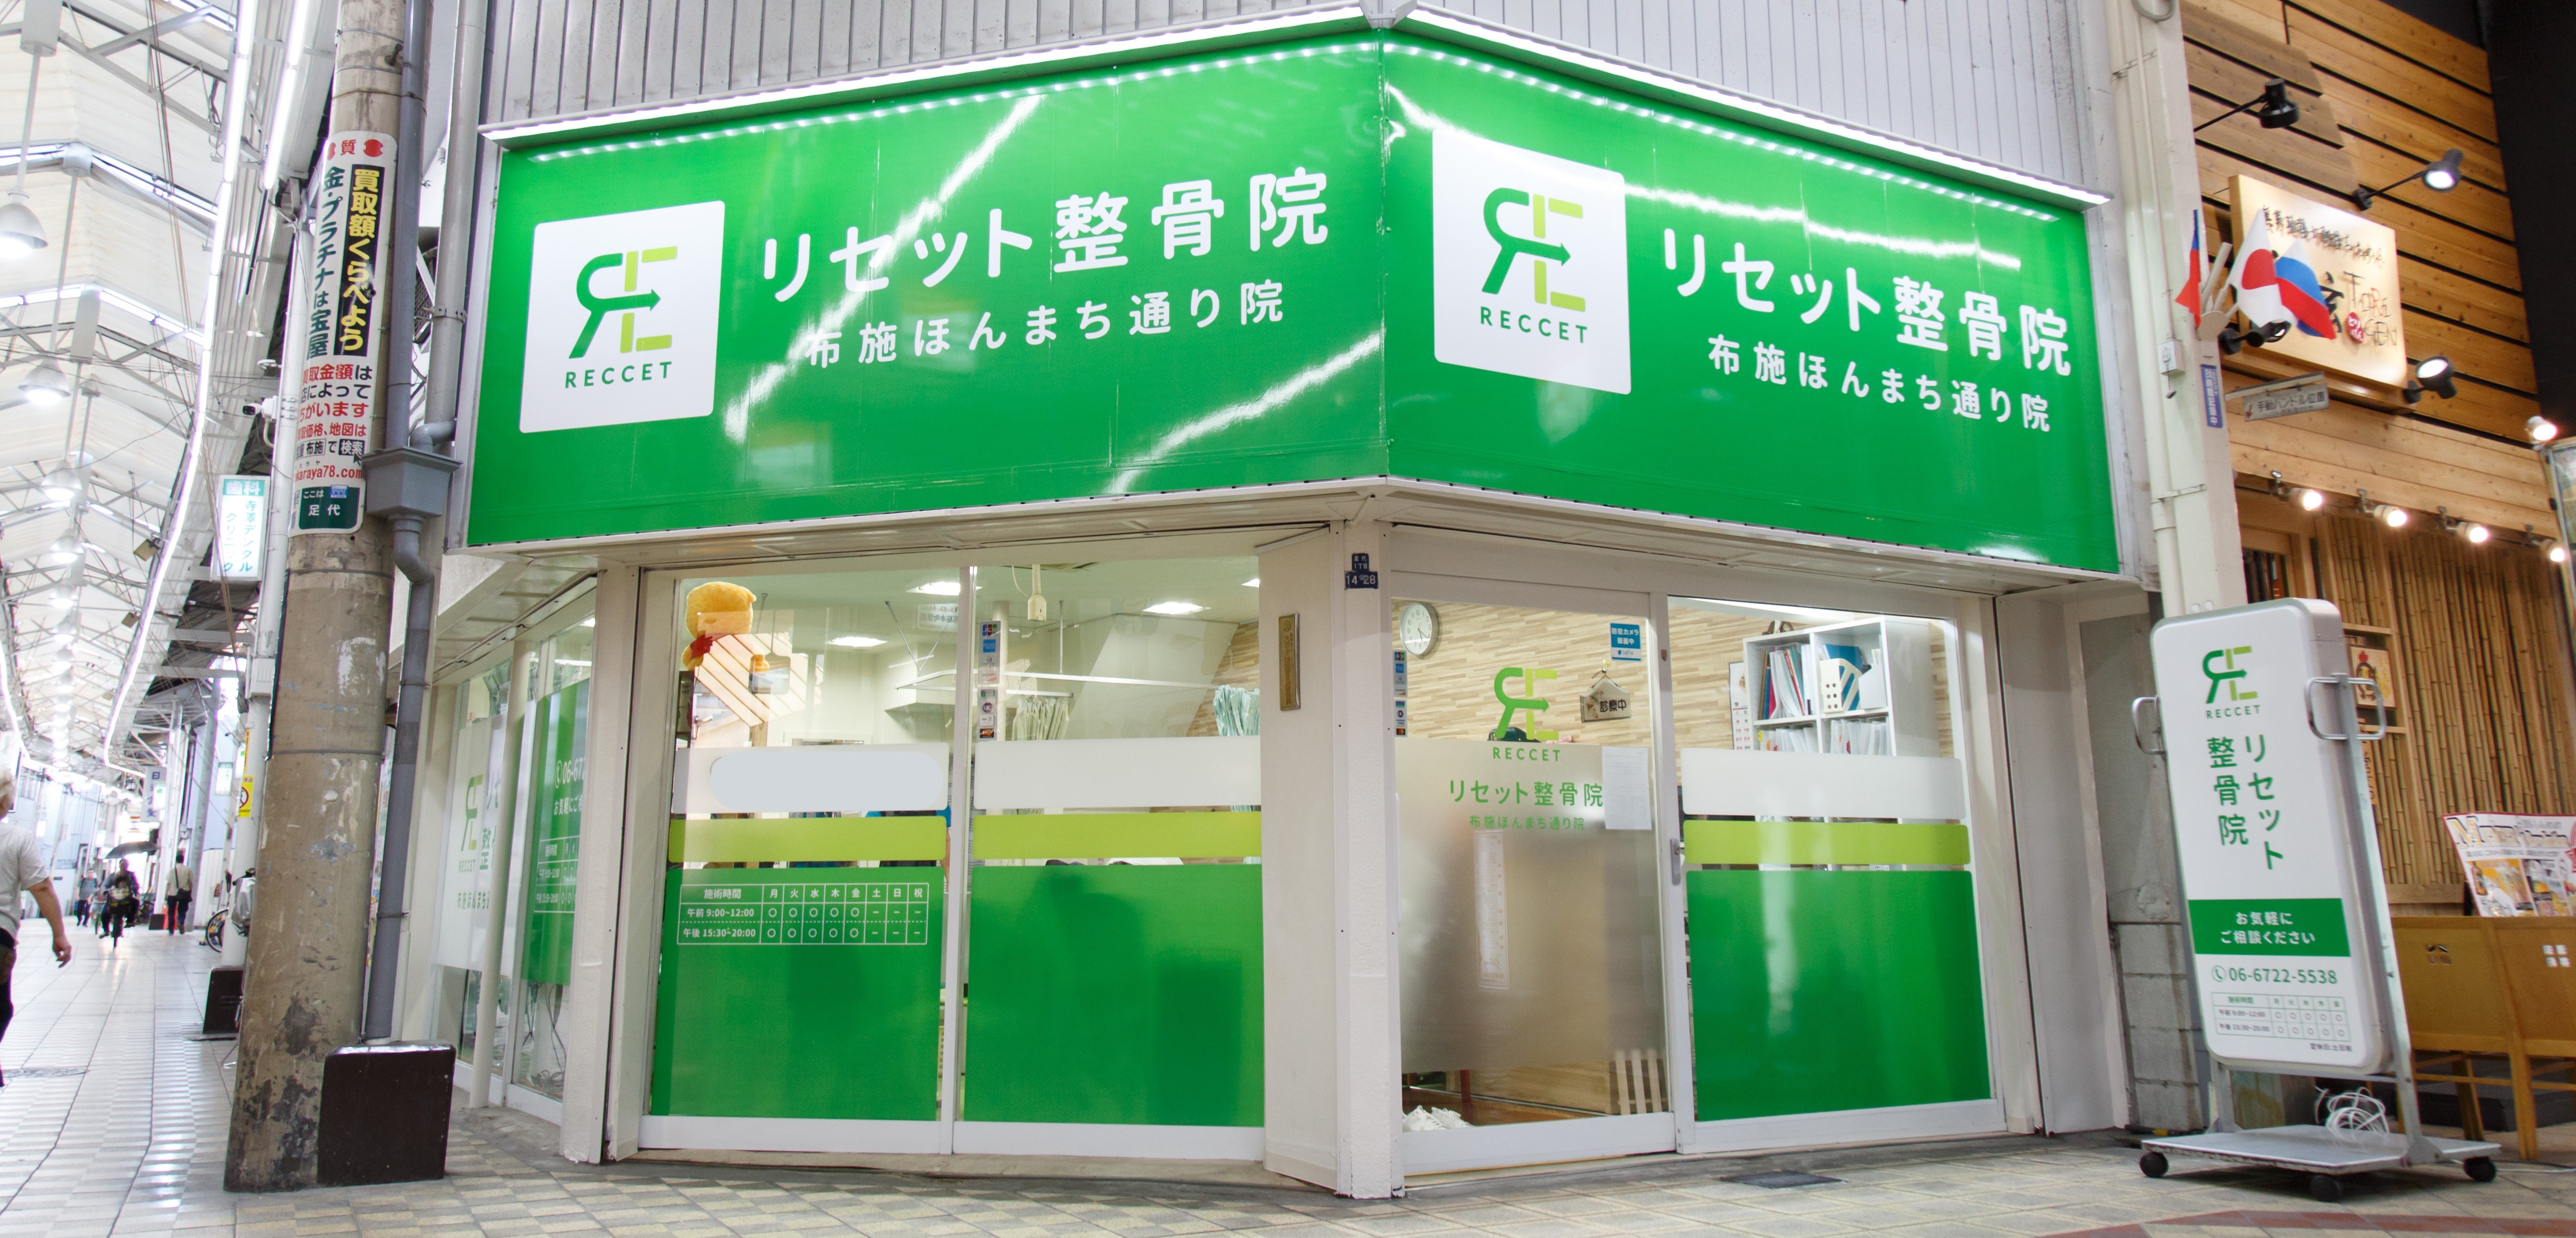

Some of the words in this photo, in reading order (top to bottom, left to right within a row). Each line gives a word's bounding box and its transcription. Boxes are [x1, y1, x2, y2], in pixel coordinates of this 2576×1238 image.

[340, 140, 356, 155] 質
[765, 167, 1328, 302] リセット整骨院
[306, 166, 345, 361] 金・プラチナは宝屋
[339, 169, 380, 351] 買取額くらべよう
[1664, 228, 2071, 376] リセット整骨院
[805, 280, 1283, 368] 布施ほんまち通り院
[1480, 306, 1588, 344] RECCET
[302, 363, 373, 386] 買取金額は
[565, 361, 672, 388] RECCET
[1708, 334, 2050, 432] 布施ほんまち通り院
[301, 382, 372, 404] 店によって
[299, 401, 369, 422] ちがいます
[307, 441, 324, 455] 布施
[328, 441, 337, 453] で
[341, 440, 363, 455] 検索
[226, 481, 261, 495] 歯科
[303, 490, 324, 499] ここは
[309, 504, 341, 517] 足代
[2206, 705, 2261, 719] RECCET
[1493, 747, 1561, 762] RECCET
[1450, 779, 1604, 807] リセット整骨院
[2206, 736, 2249, 846] 整骨院
[2245, 734, 2284, 870] リセット
[1469, 815, 1585, 831] 布施ほんまち通り院
[704, 889, 742, 899] 施術時間
[770, 889, 778, 898] 月
[790, 889, 798, 898] 火
[810, 889, 819, 898] 水
[831, 888, 840, 898] 木
[851, 888, 861, 898] 金
[872, 888, 881, 898] 土
[894, 889, 901, 897] 日
[914, 888, 923, 898] 祝
[687, 908, 704, 918] 午前
[2236, 912, 2293, 926] お気軽に
[683, 928, 700, 937] 午後
[2221, 930, 2316, 945] ご相談ください
[2229, 968, 2338, 984] 06-6722-5538
